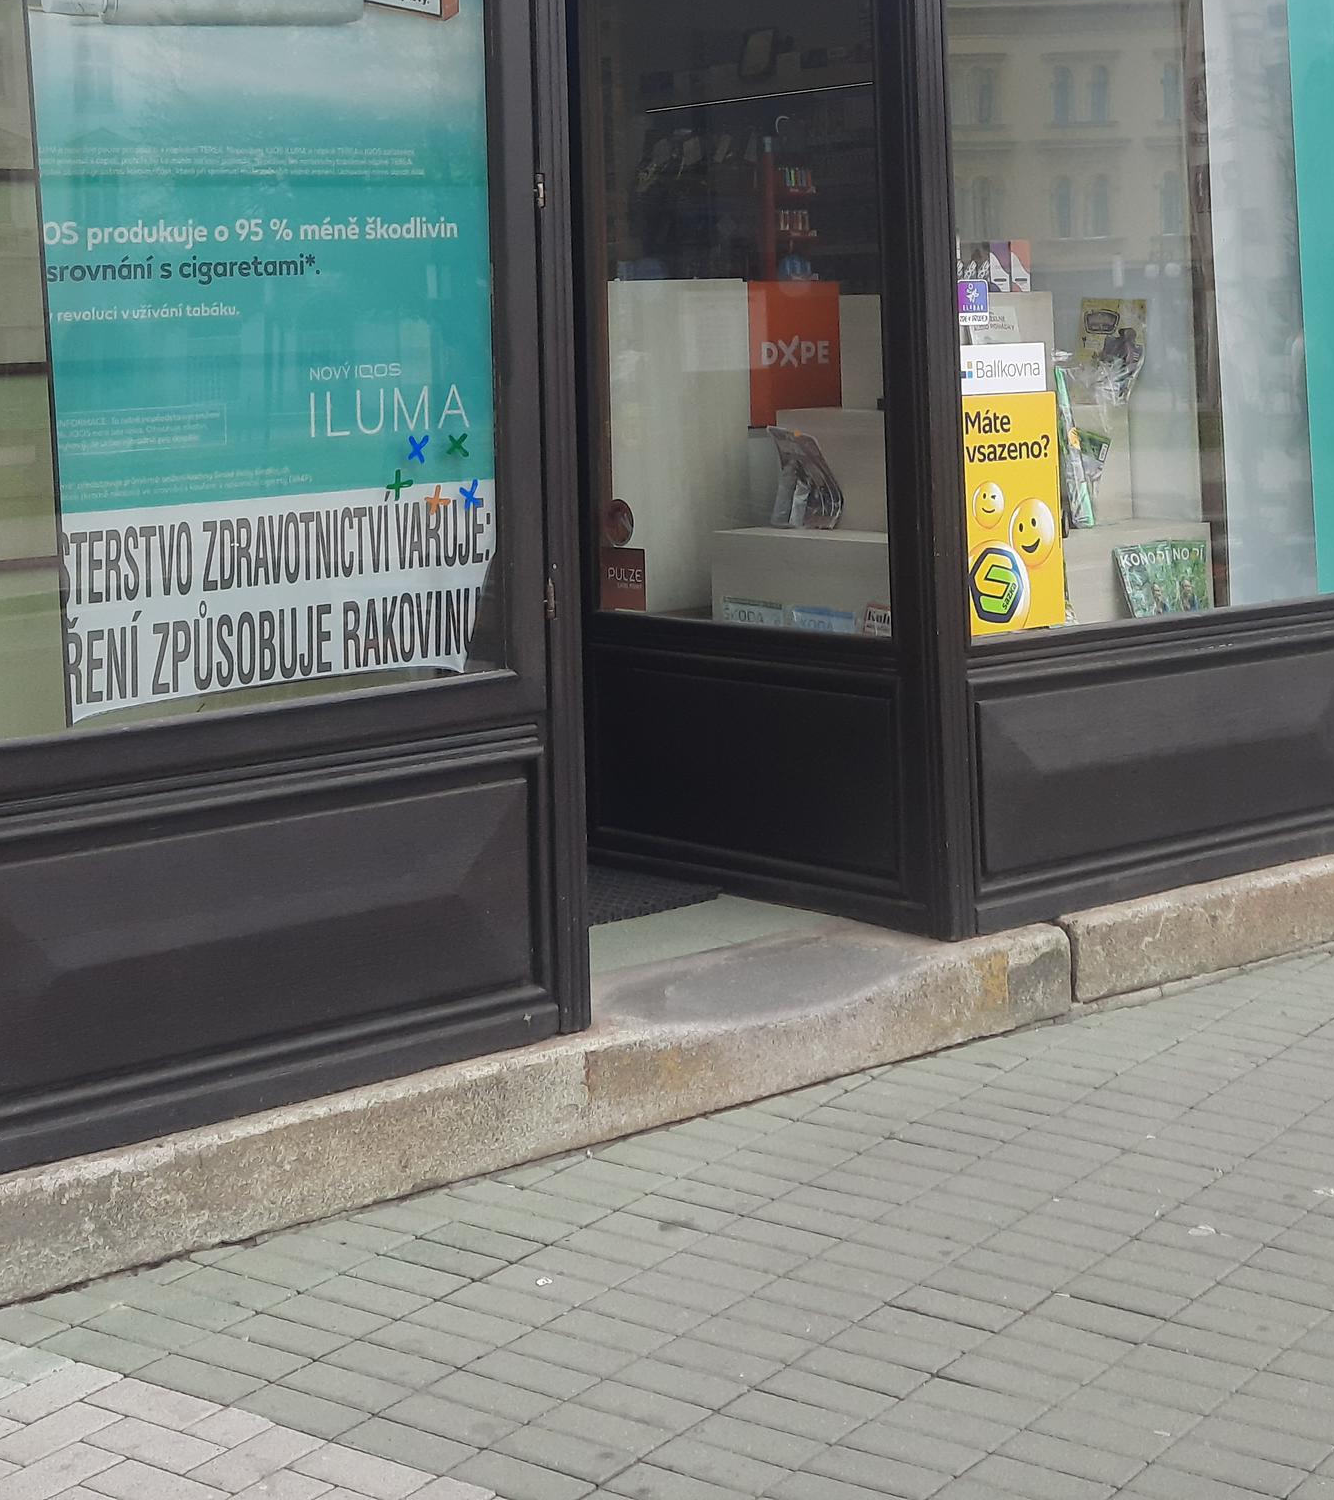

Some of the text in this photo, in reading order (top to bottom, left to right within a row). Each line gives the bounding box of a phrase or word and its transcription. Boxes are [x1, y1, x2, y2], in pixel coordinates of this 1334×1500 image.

[87, 219, 208, 251] produkuje
[214, 225, 229, 242] o
[235, 219, 263, 242] 95
[269, 218, 293, 241] %
[299, 217, 360, 241] méně
[365, 216, 459, 239] škodlivin
[46, 255, 152, 282] srovnání
[160, 262, 172, 279] s
[57, 306, 117, 321] revoluci
[132, 303, 183, 320] užívání
[185, 302, 241, 317] tabáku.
[309, 361, 403, 381] NOVÝ IQOS
[976, 359, 1040, 379] Balíkovna
[309, 383, 470, 438] ILUMA
[964, 409, 1011, 435] Máte
[966, 434, 1050, 463] vsazeno?
[202, 491, 392, 592] ZDRAVOTNICTVÍ
[394, 496, 492, 571] VARUJE:
[607, 567, 643, 583] PULZE
[152, 600, 333, 696] ZPŮSOBUJE
